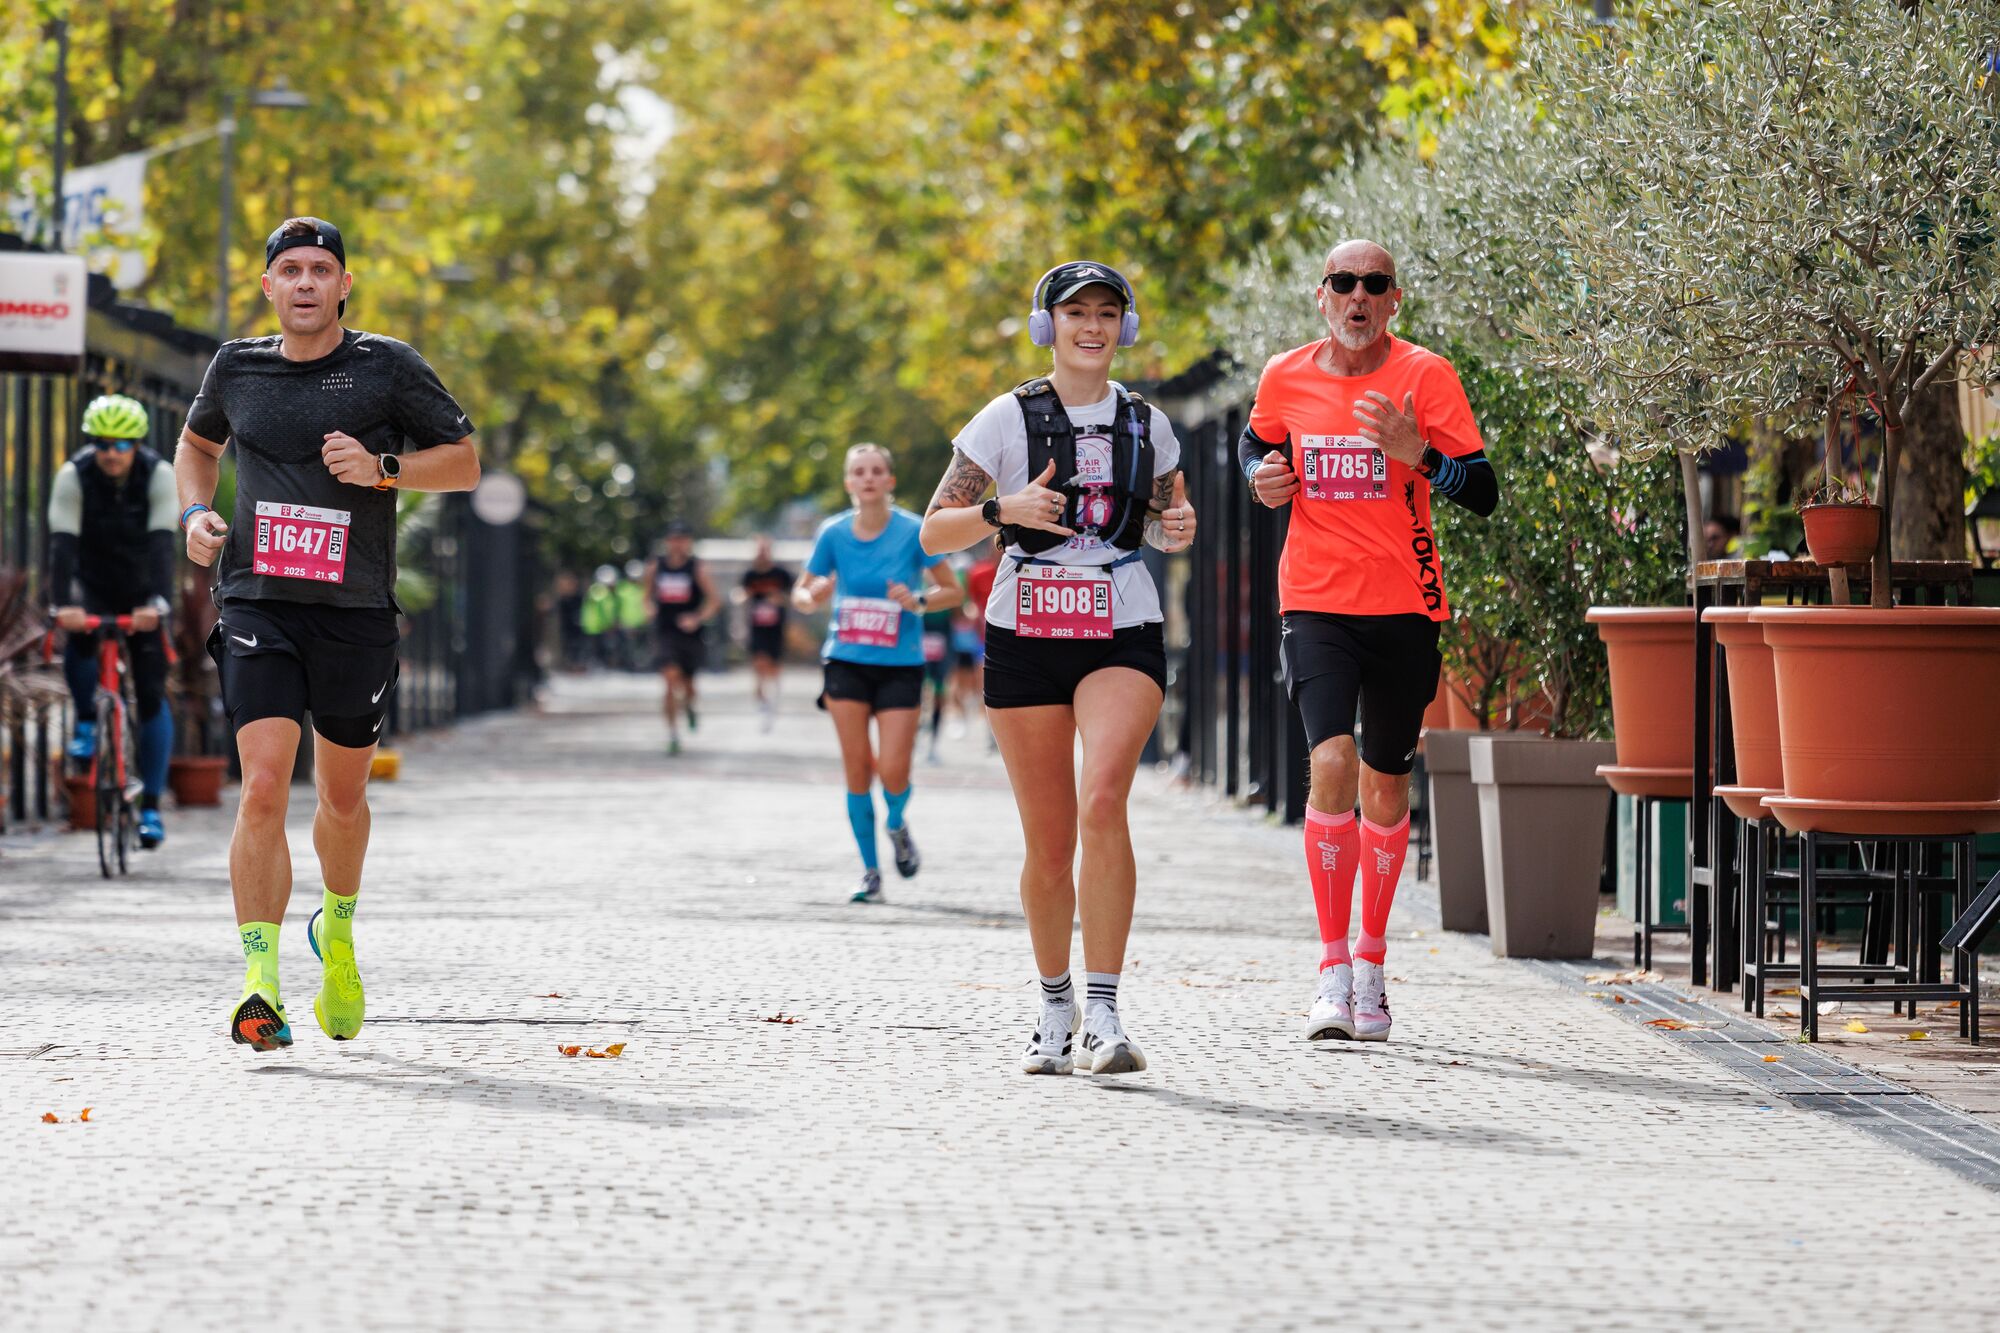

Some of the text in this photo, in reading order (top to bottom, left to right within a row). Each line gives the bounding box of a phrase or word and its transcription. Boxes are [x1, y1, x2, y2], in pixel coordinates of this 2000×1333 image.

[1084, 459, 1100, 467] AIR
[1320, 454, 1369, 479] 1785
[273, 524, 327, 555] 1647
[283, 566, 306, 576] 2025
[1034, 586, 1091, 614] 1908
[1051, 627, 1074, 637] 2025
